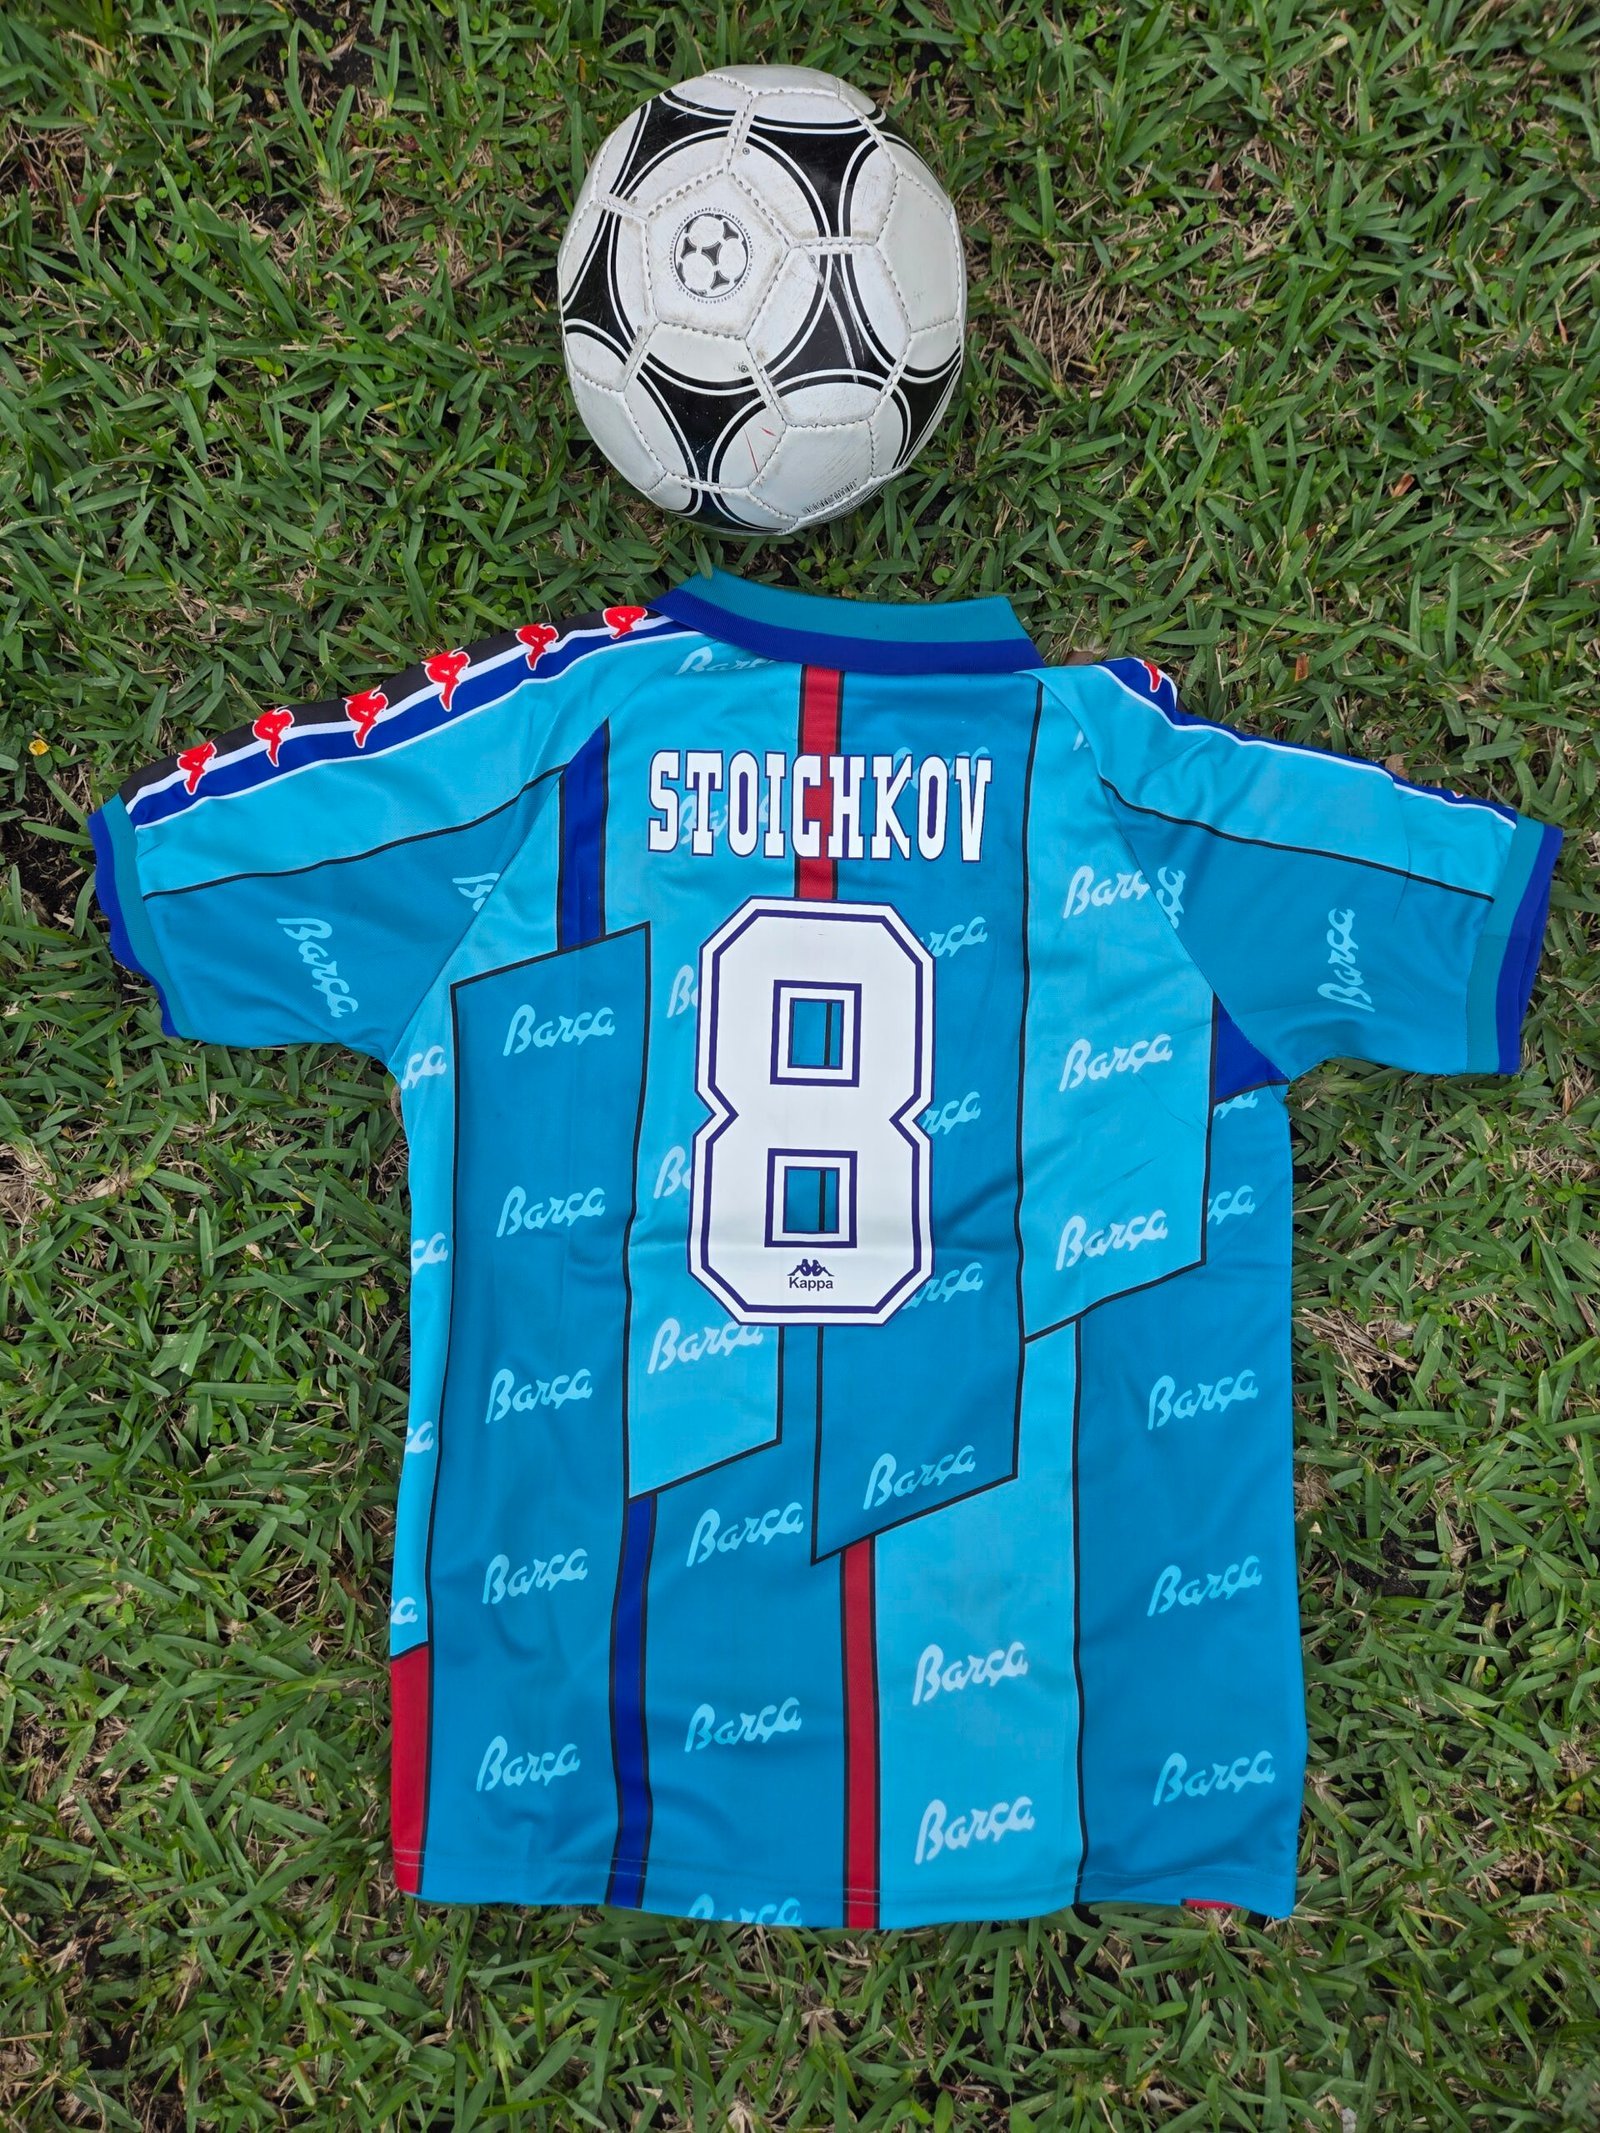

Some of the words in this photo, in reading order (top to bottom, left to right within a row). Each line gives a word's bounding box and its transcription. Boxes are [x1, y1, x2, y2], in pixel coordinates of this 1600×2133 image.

[648, 749, 993, 862] STOICHKOV
[276, 917, 359, 1018] Barça
[1317, 908, 1375, 1012] Barça
[502, 1004, 616, 1057] Barça
[1058, 1033, 1173, 1092] Barça
[688, 896, 935, 1326] 8
[496, 1185, 606, 1238] Barça
[1055, 1209, 1169, 1271] Barça
[788, 1277, 834, 1292] Kappa
[485, 1368, 593, 1423] Barça
[1147, 1369, 1259, 1430] Barça
[863, 1445, 977, 1510] Barça
[686, 1502, 804, 1567] Barça
[482, 1548, 588, 1604] Barça
[1147, 1555, 1263, 1617] Barça
[912, 1641, 1029, 1706] Barça
[684, 1697, 802, 1752] Barça
[476, 1735, 580, 1791] Barça
[1153, 1750, 1276, 1806] Barça
[914, 1796, 1035, 1865] Barça
